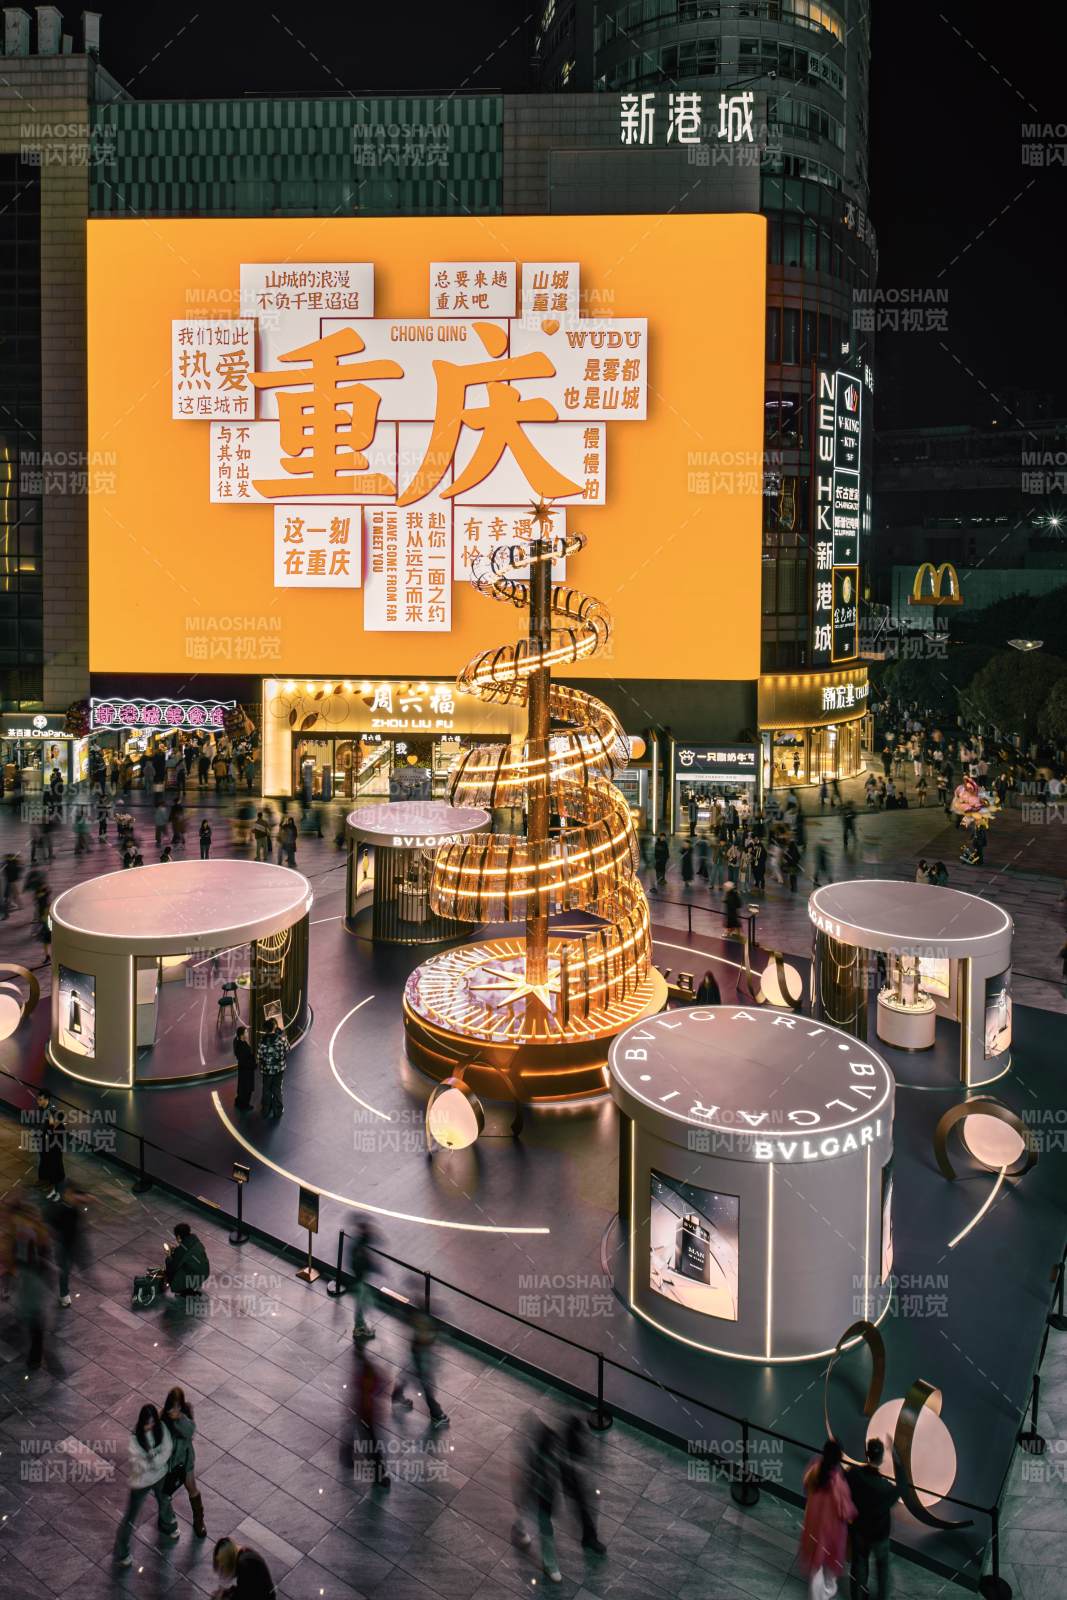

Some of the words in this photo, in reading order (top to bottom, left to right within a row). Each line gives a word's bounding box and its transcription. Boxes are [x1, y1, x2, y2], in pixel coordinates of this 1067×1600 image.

[619, 91, 754, 146] 新港城
[264, 270, 351, 289] 山城的浪漫
[434, 270, 508, 288] 总要来趟
[532, 270, 569, 289] 山城
[435, 292, 490, 310] 重庆吧
[532, 293, 569, 312] 重逢
[178, 326, 249, 346] 我们如此
[390, 325, 434, 342] CHONG
[437, 325, 467, 343] QING
[566, 330, 642, 349] WUDU
[178, 349, 250, 391] 热爱
[583, 358, 641, 382] 是雾都
[178, 394, 249, 415] 这座城市
[564, 386, 641, 410] 也是山城
[247, 322, 585, 507] 重庆
[818, 371, 835, 461] NEW
[217, 425, 233, 498] 与其向往
[235, 426, 251, 498] 不如出发
[372, 511, 384, 523] TO
[283, 516, 351, 545] 这一刻
[372, 525, 384, 551] MEET
[386, 517, 397, 543] HAVE
[283, 548, 351, 576] 在重庆
[372, 552, 384, 573] YOU
[386, 544, 397, 572] COME
[405, 512, 423, 622] 我从远方而来
[427, 512, 446, 623] 赴你一面之约
[386, 574, 397, 602] FROM
[814, 541, 832, 652] 新港城
[386, 603, 397, 622] FAR
[369, 684, 456, 714] 周六福
[7, 728, 32, 738] 茶百道
[371, 718, 409, 729] ZHOU
[411, 719, 432, 729] LIU
[435, 719, 454, 729] FU
[360, 733, 382, 742] 周六福
[754, 1119, 883, 1161] BVLGARI
